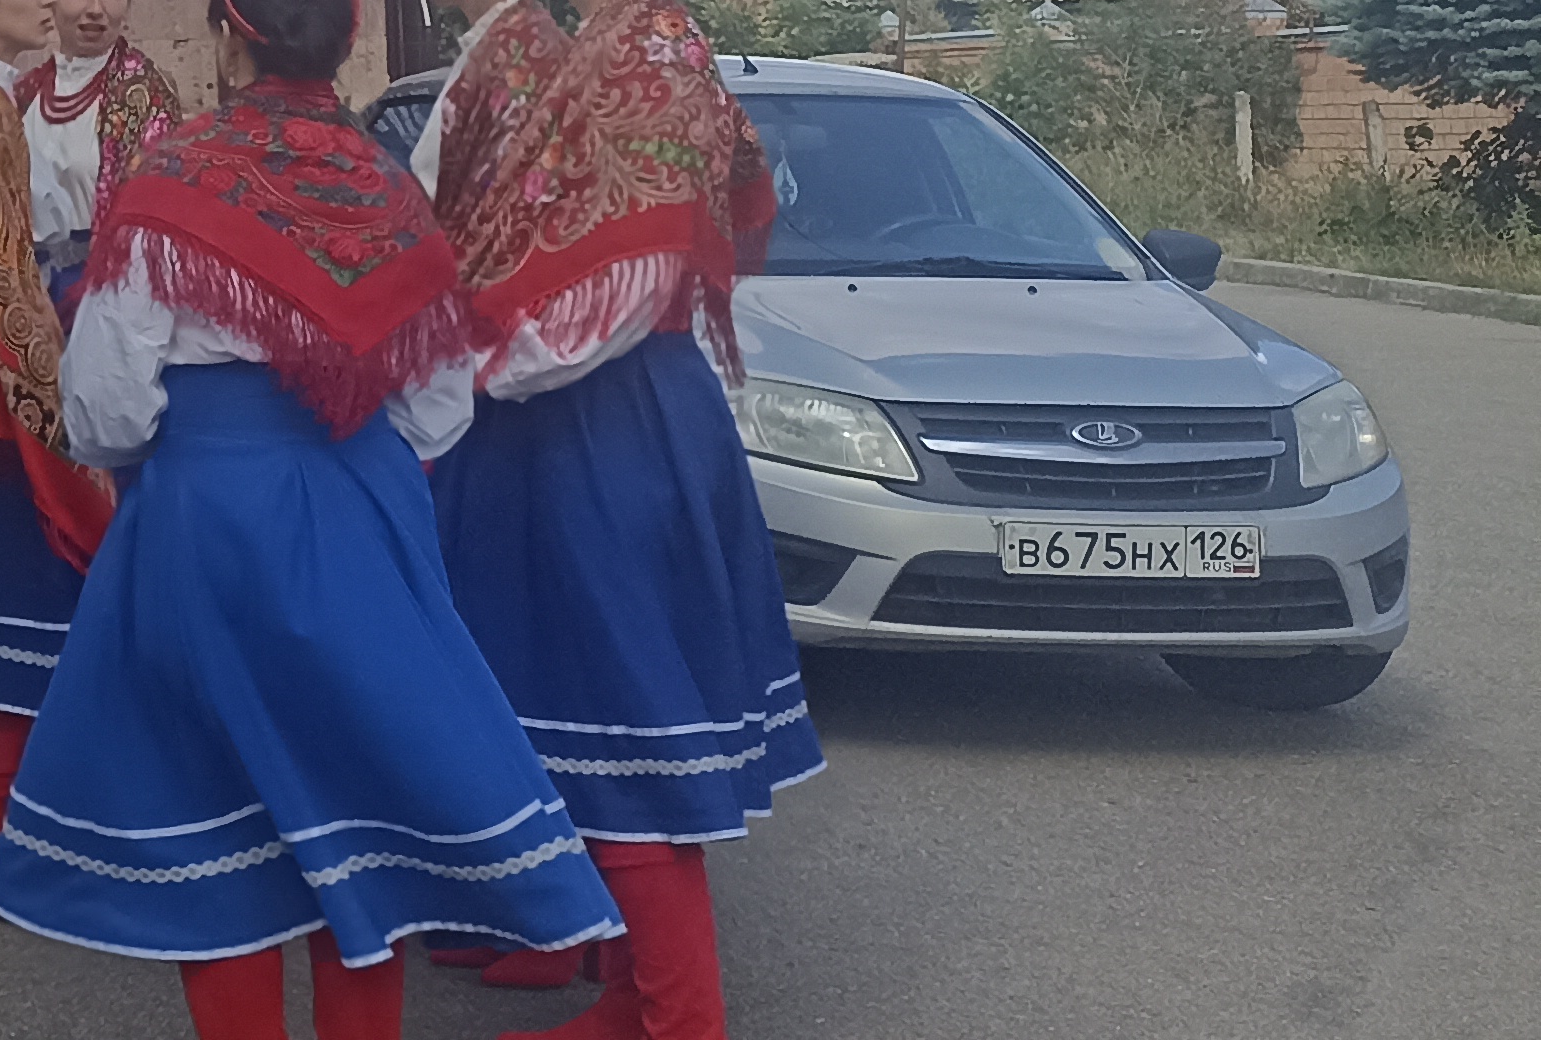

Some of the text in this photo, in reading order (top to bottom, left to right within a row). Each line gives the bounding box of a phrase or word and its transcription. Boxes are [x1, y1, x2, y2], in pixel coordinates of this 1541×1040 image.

[1018, 531, 1248, 571] В675НХ 126
[1202, 561, 1232, 573] RUS
